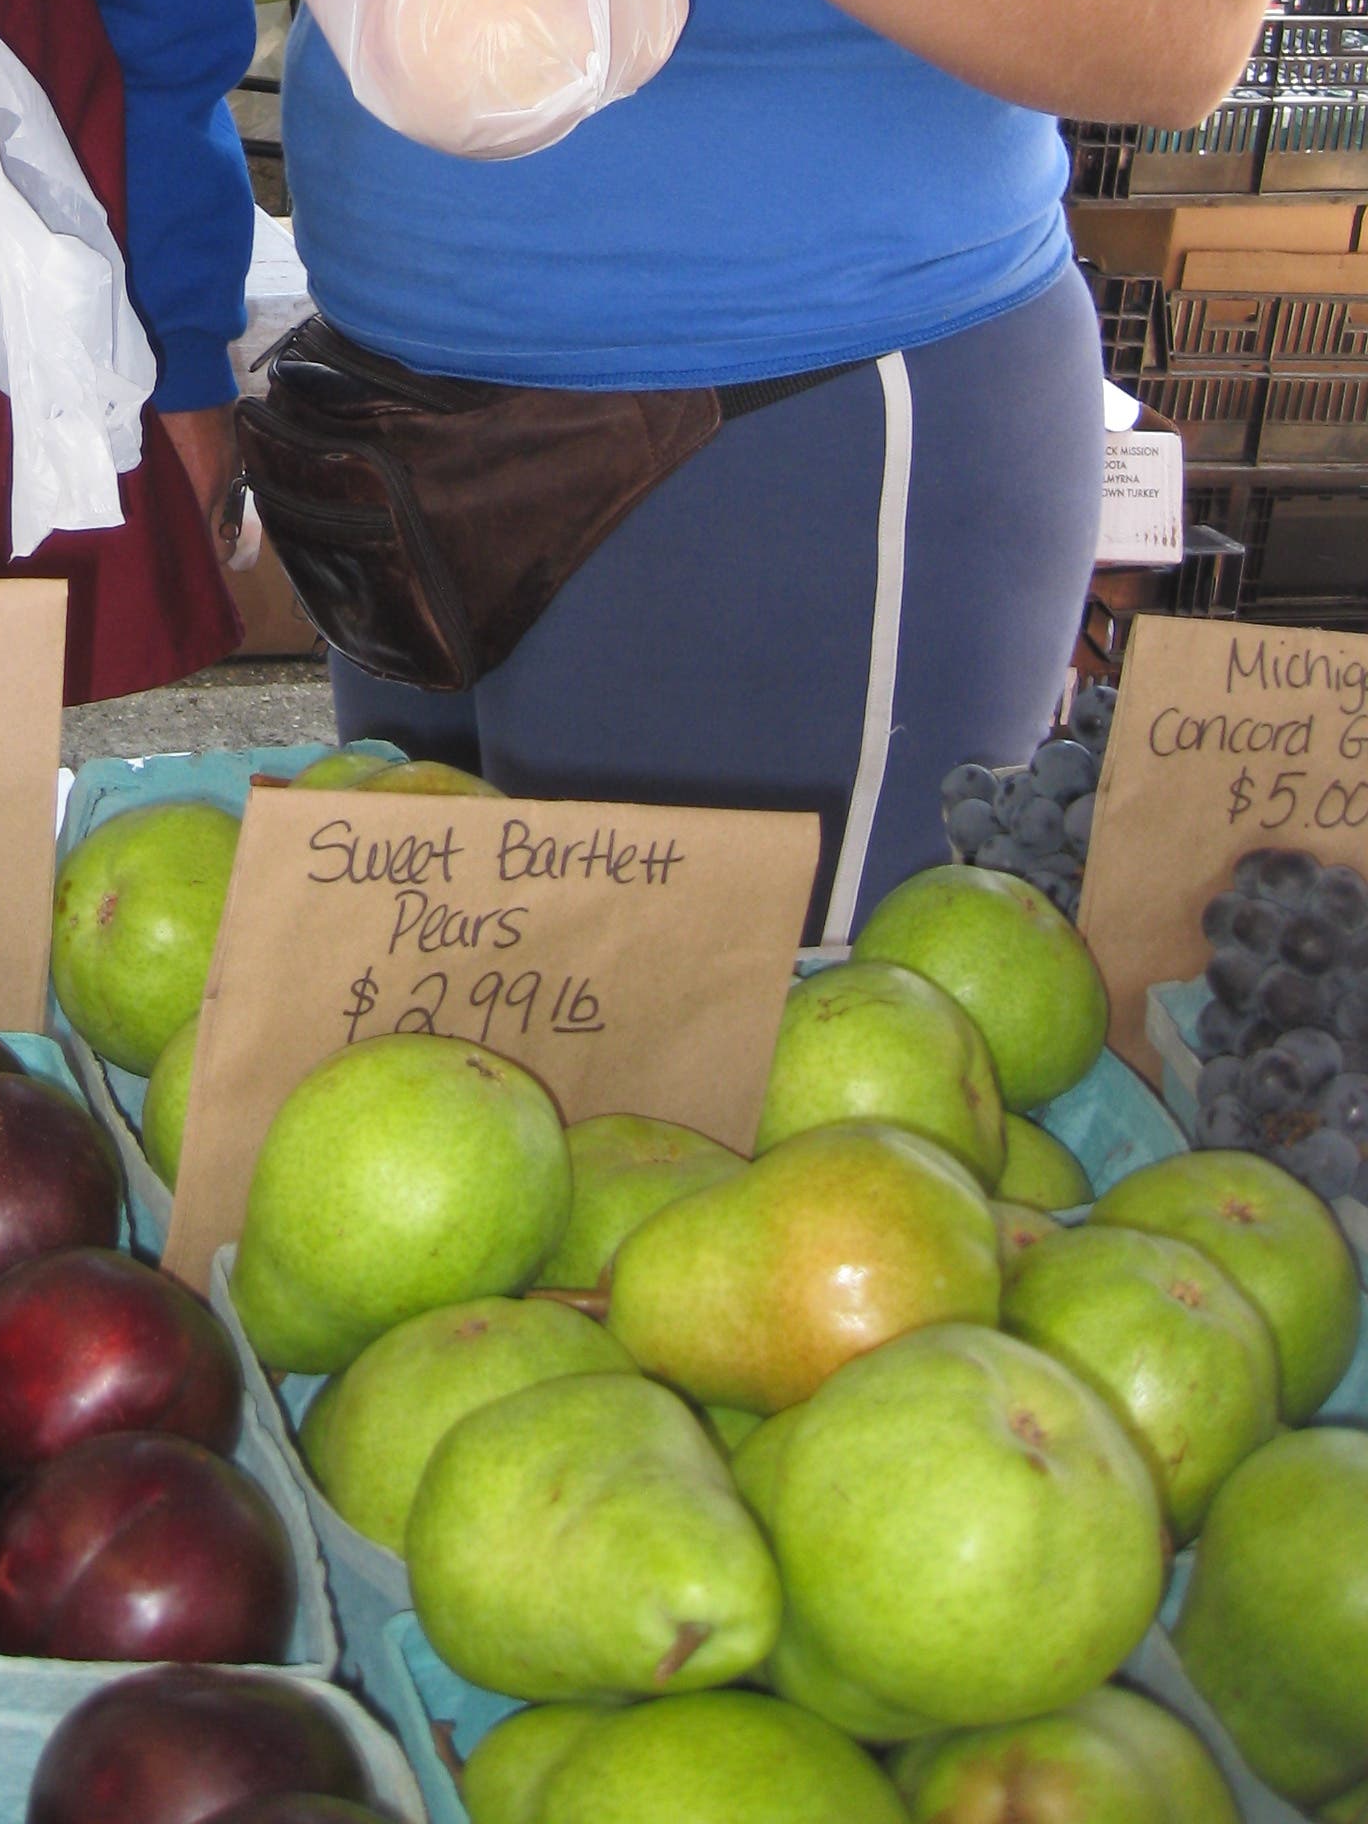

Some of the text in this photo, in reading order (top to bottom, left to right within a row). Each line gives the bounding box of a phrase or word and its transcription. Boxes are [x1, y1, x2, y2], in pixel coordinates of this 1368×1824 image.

[1120, 446, 1160, 457] MISSION
[1127, 488, 1160, 498] TURKEY
[1149, 707, 1314, 757] Concord
[307, 819, 684, 884] Sweet Bartlett
[388, 888, 529, 955] Pears
